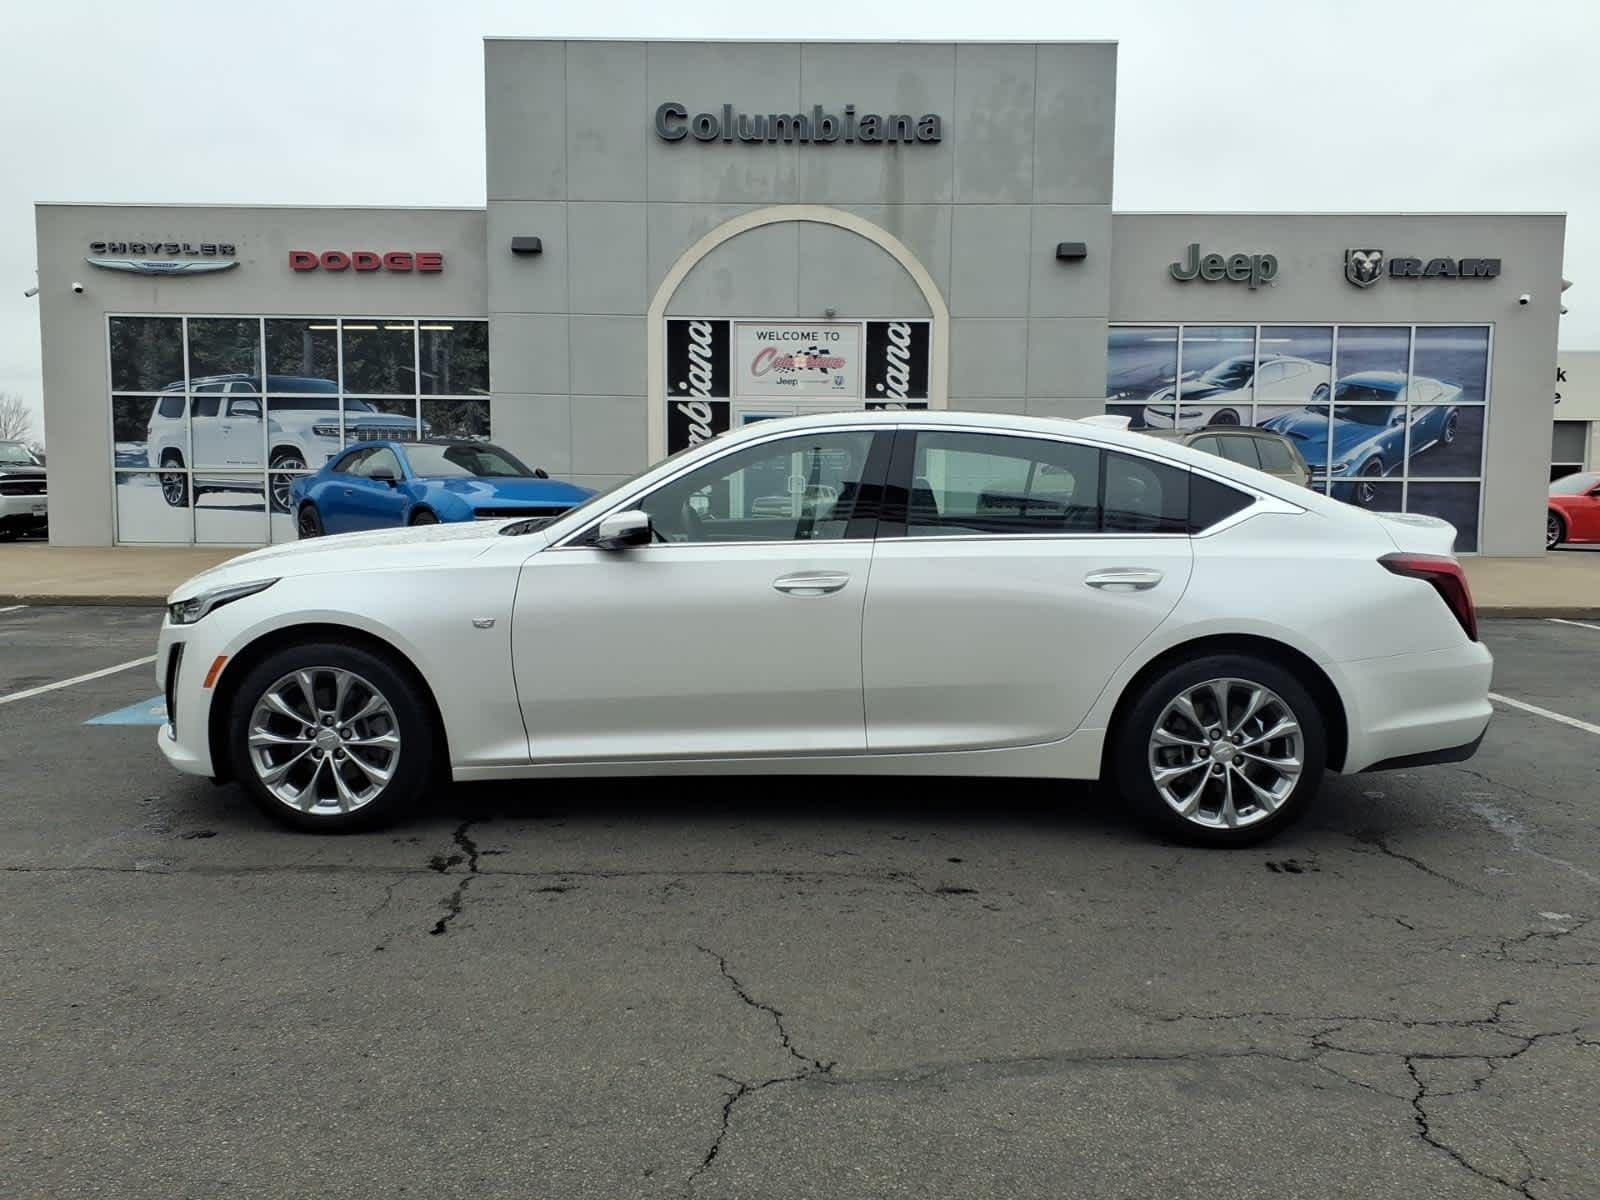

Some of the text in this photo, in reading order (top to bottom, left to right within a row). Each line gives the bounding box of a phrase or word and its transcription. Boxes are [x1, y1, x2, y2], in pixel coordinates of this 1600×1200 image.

[655, 102, 942, 143] Columbiana
[89, 242, 236, 256] CHRYSLER
[289, 251, 443, 272] DODGE
[1168, 243, 1278, 289] Jeep
[1389, 258, 1502, 278] RAM
[756, 331, 840, 341] WELCOME TO
[776, 377, 799, 386] Jeep
